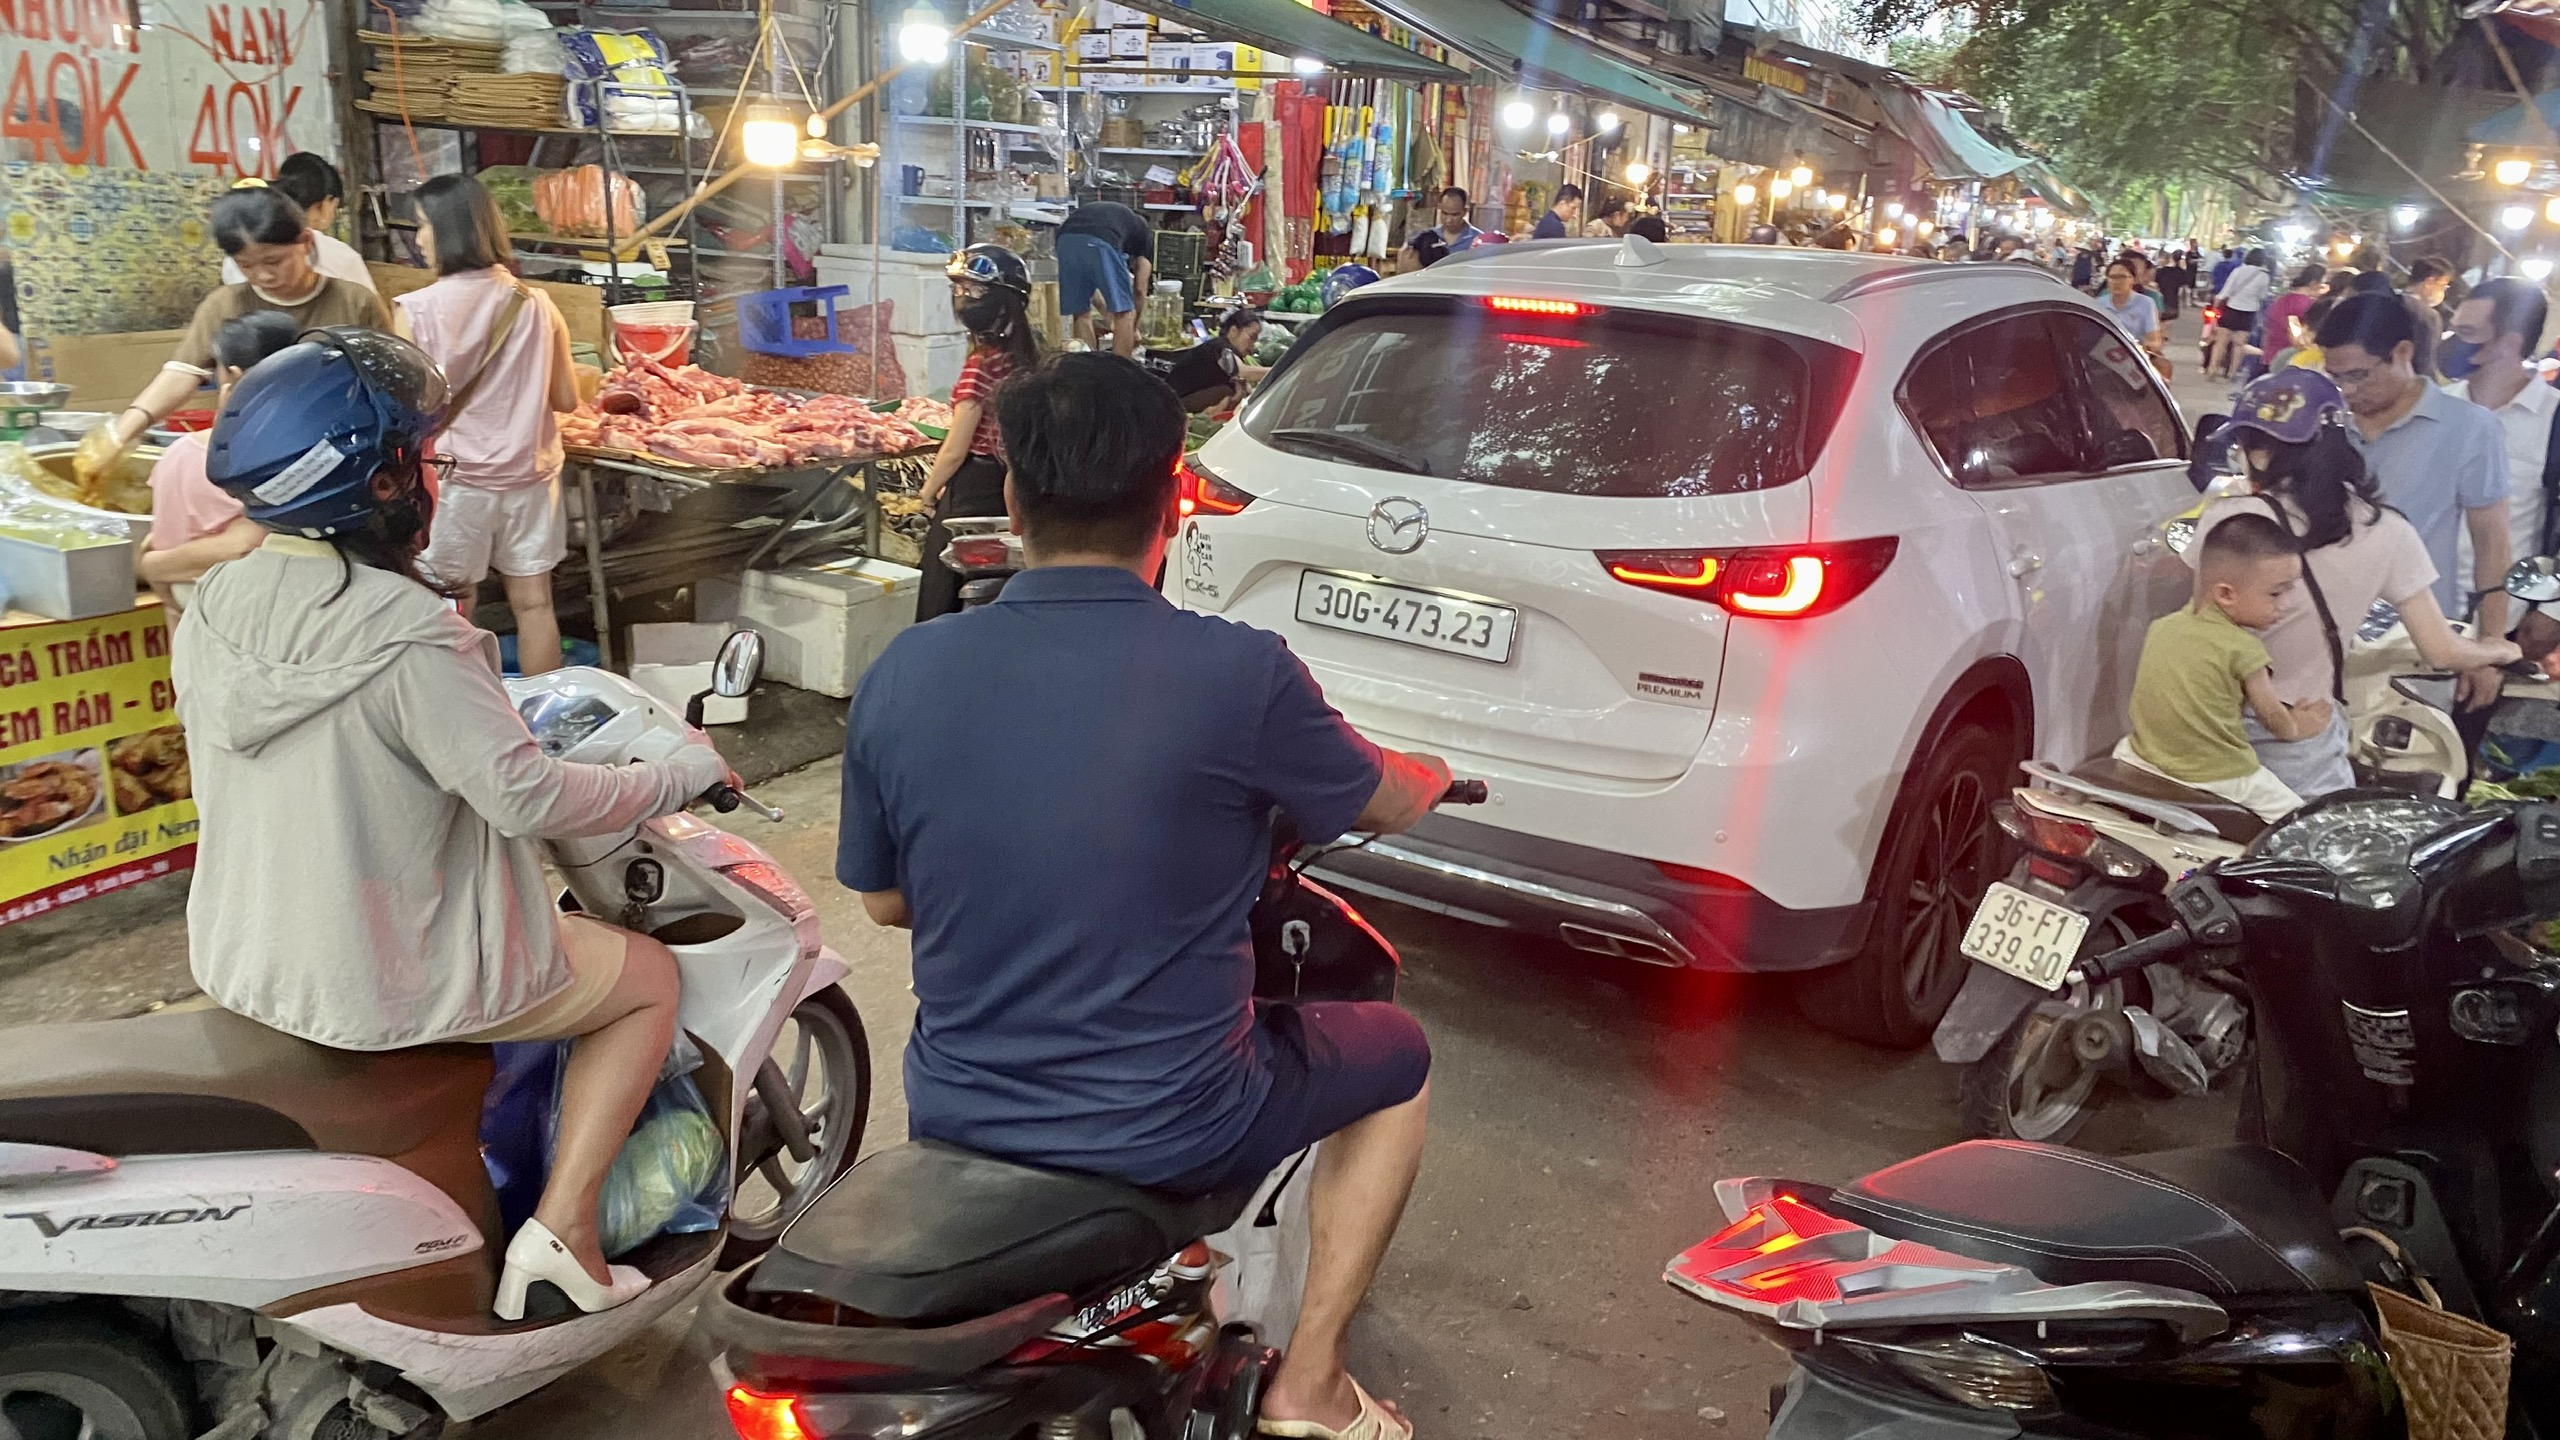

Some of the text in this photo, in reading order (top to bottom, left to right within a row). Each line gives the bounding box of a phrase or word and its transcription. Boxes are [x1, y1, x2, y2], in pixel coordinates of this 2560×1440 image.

[2, 50, 148, 171] 40K
[188, 82, 303, 179] 40K
[1201, 552, 1213, 561] CAR
[1185, 577, 1219, 598] CX-5
[1314, 584, 1494, 648] 30G-473.23
[0, 642, 38, 687] CÁ
[53, 689, 112, 735] RÁN
[1637, 682, 1701, 699] PREMIUM
[1995, 894, 2069, 945] 36-F1
[1971, 923, 2062, 982] 339.90
